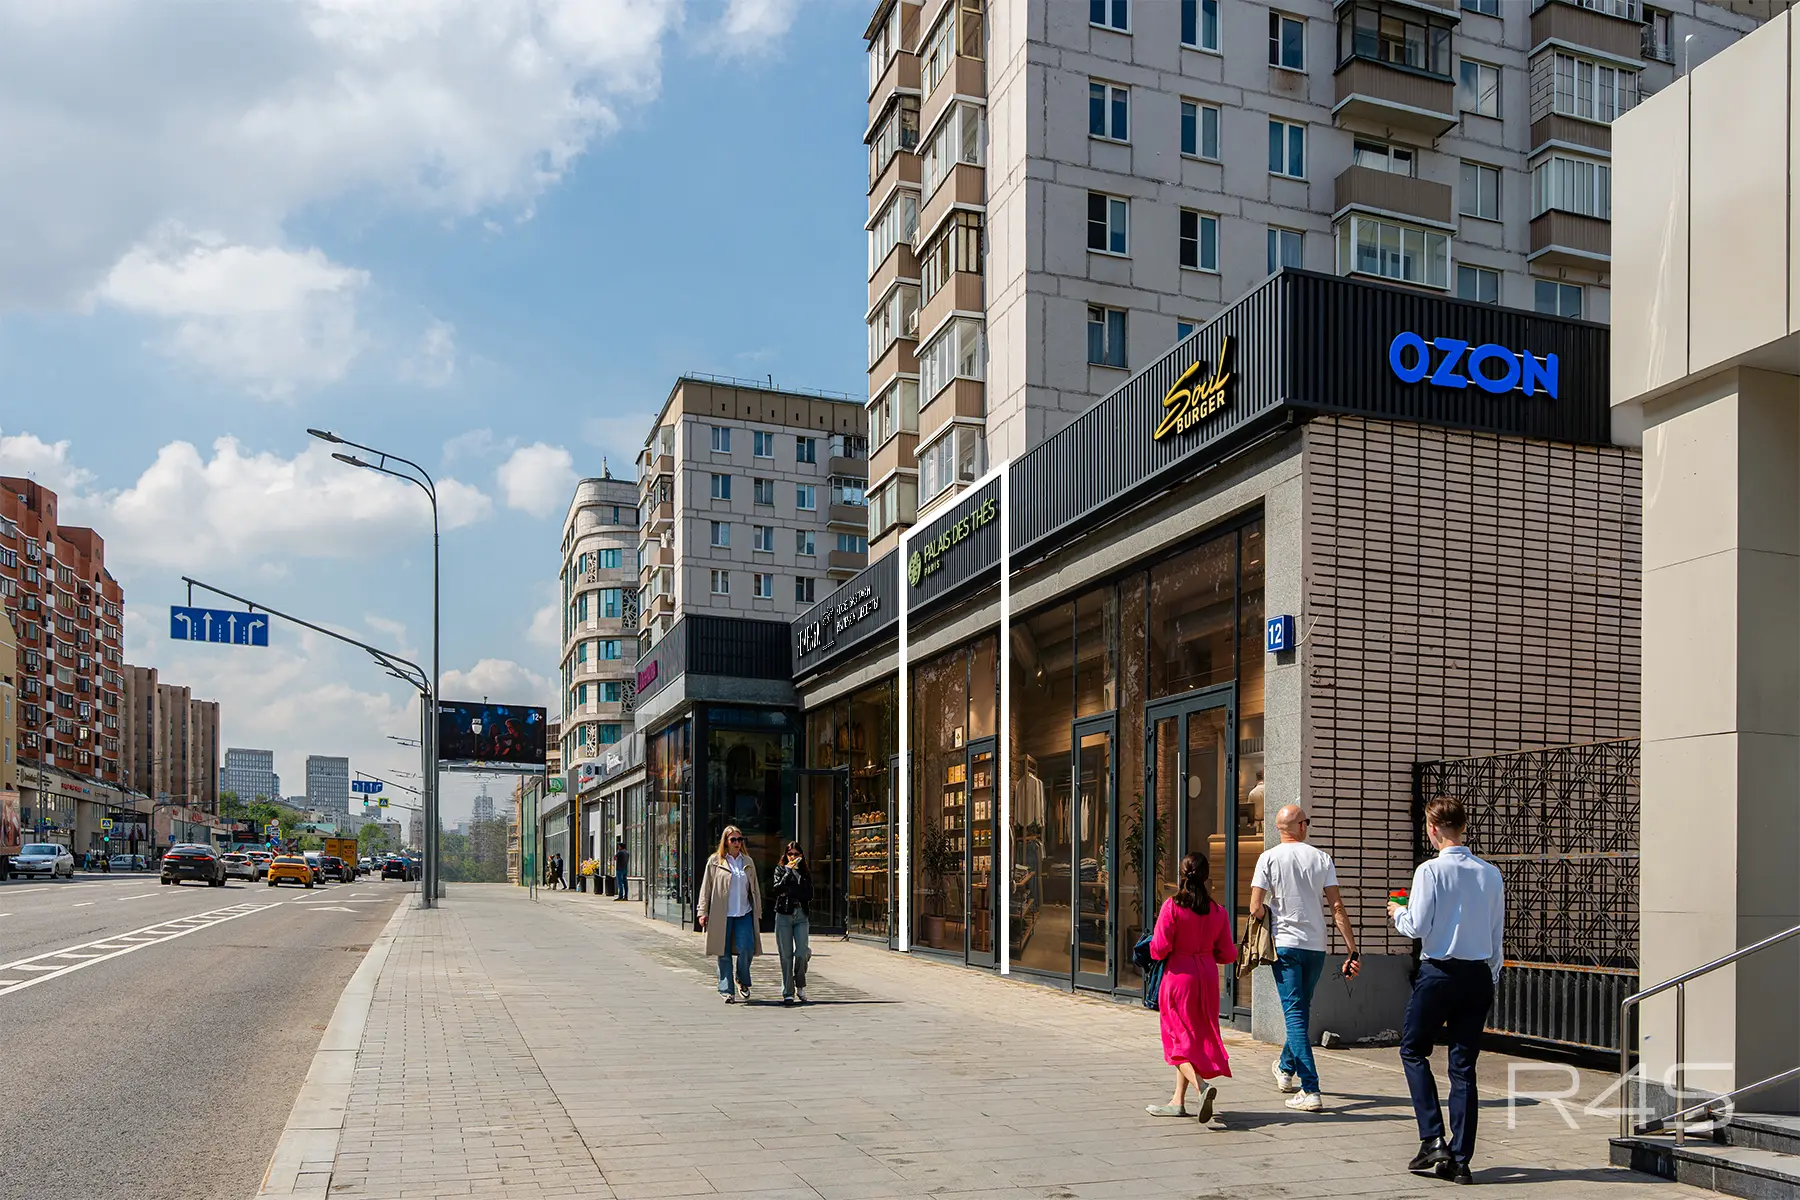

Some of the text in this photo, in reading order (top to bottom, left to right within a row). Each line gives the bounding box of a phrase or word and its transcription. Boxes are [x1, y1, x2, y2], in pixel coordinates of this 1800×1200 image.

[1153, 335, 1231, 440] Soul
[1389, 331, 1559, 400] OZON
[1176, 389, 1225, 434] BURGER
[924, 498, 995, 563] PALAIS DES THÉS
[924, 560, 940, 576] PARIS
[1269, 623, 1282, 644] 12
[531, 713, 543, 721] 12+
